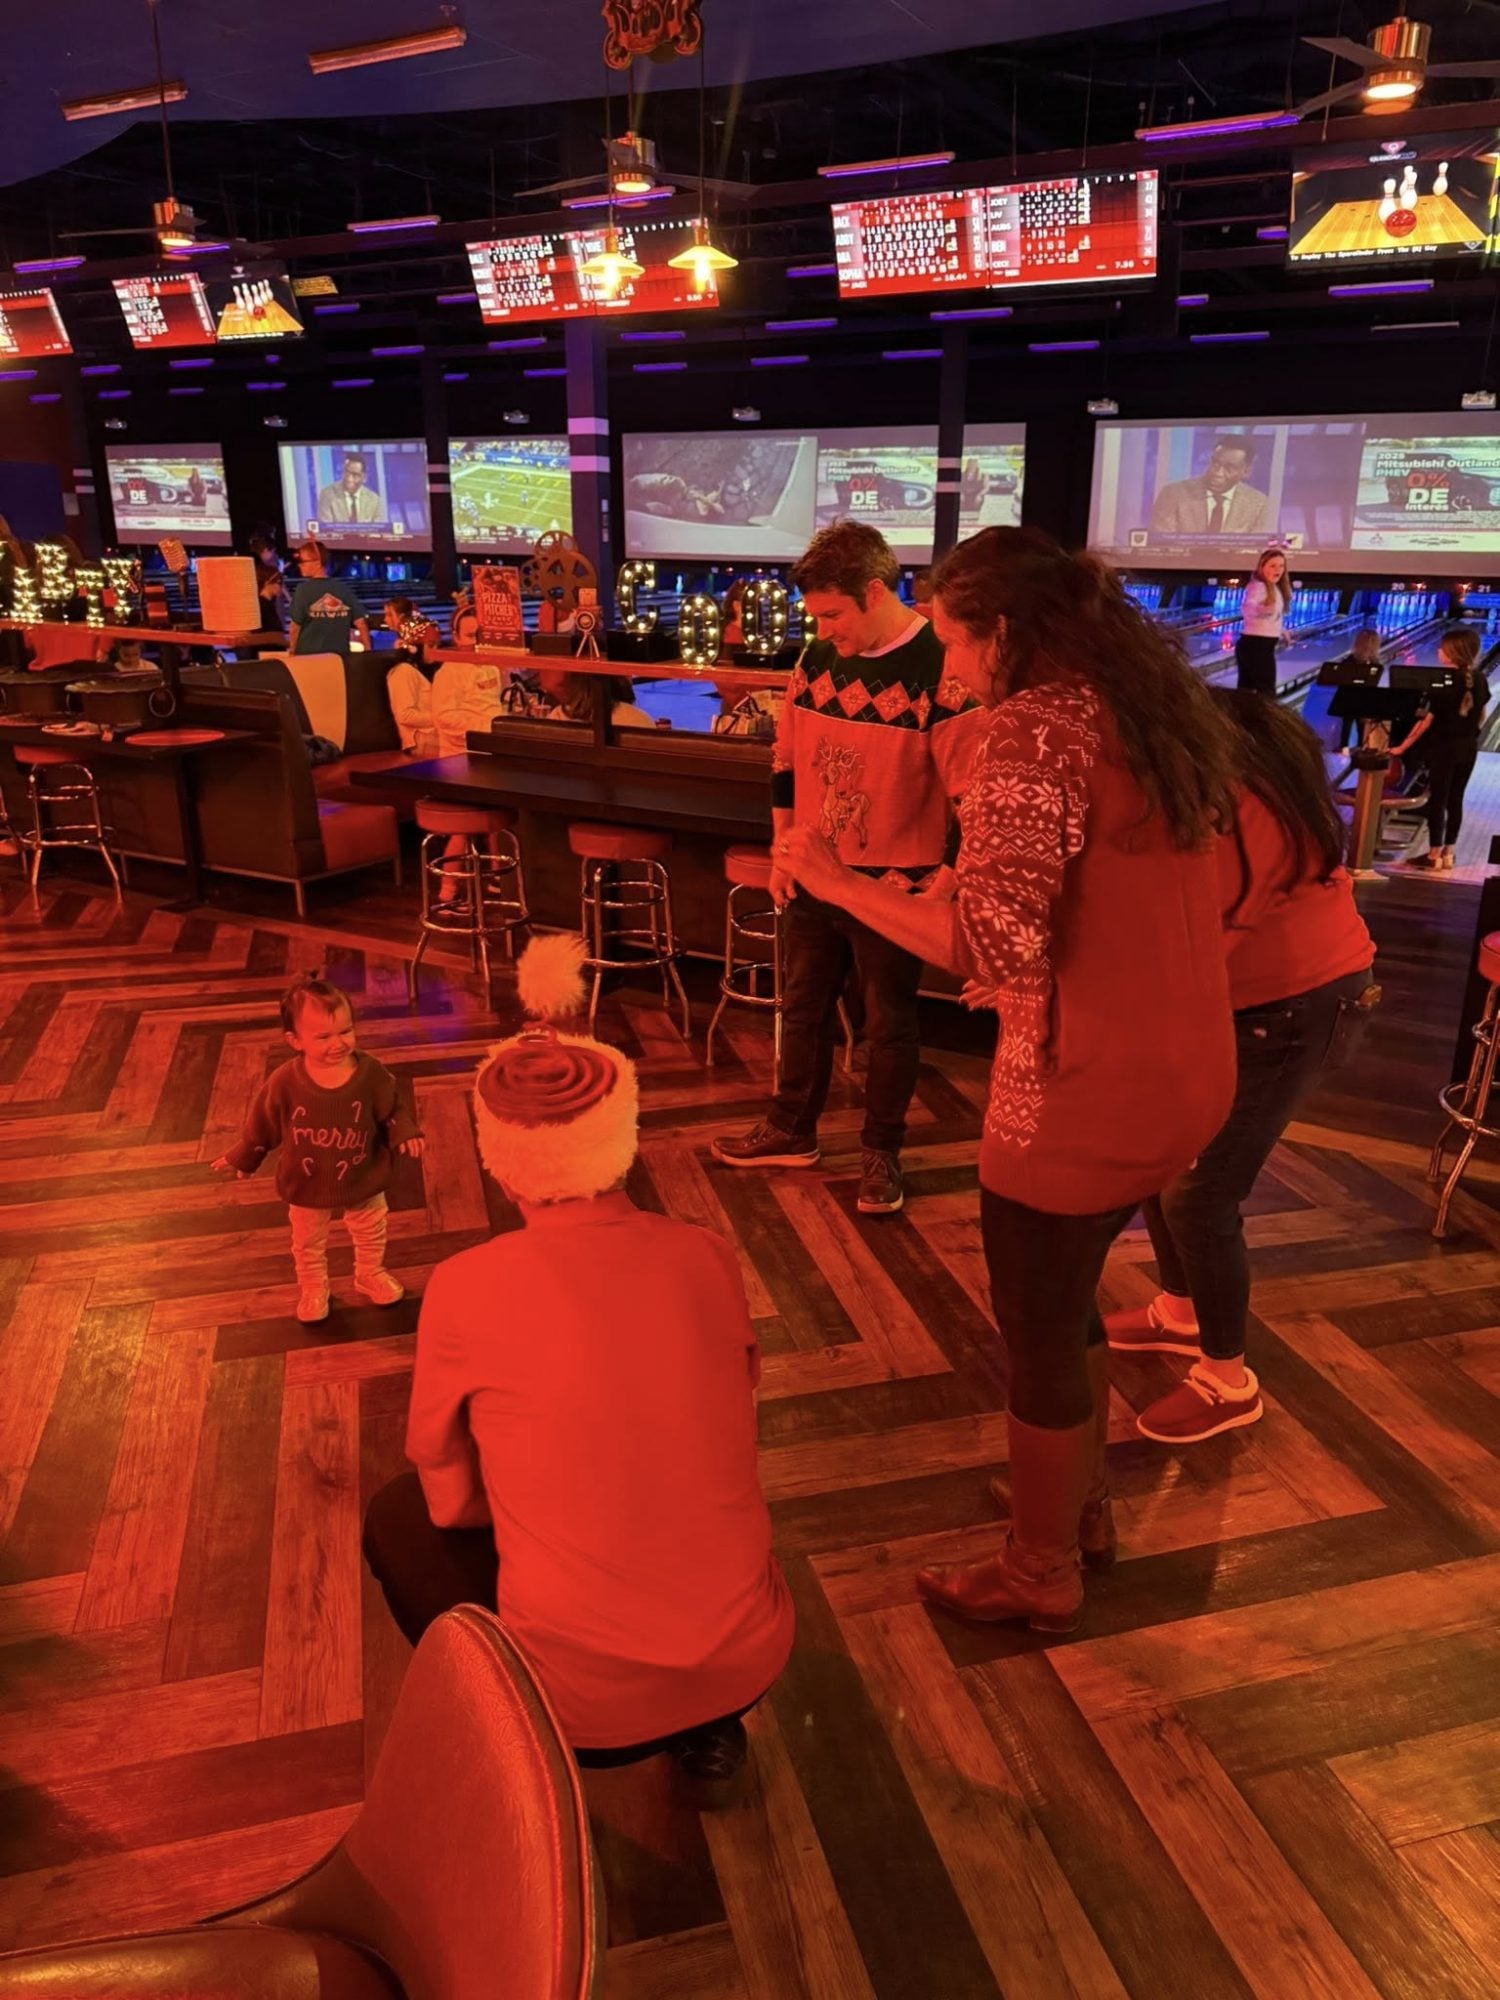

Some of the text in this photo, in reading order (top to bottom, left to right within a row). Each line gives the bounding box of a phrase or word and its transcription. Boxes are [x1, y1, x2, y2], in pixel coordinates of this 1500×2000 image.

[990, 198, 1008, 206] JOEY
[1378, 452, 1406, 460] 2025
[1376, 459, 1444, 468] Mitsubishi
[1375, 468, 1411, 477] PHEV
[848, 477, 878, 490] 0%
[1407, 472, 1450, 488] 0%
[129, 489, 148, 501] DE
[851, 490, 879, 505] DE
[1408, 487, 1450, 504] DE
[0, 541, 133, 628] ARTY
[1391, 582, 1405, 591] 20
[1477, 584, 1491, 593] 21
[481, 591, 508, 604] PIZZA
[292, 1127, 368, 1165] merry
